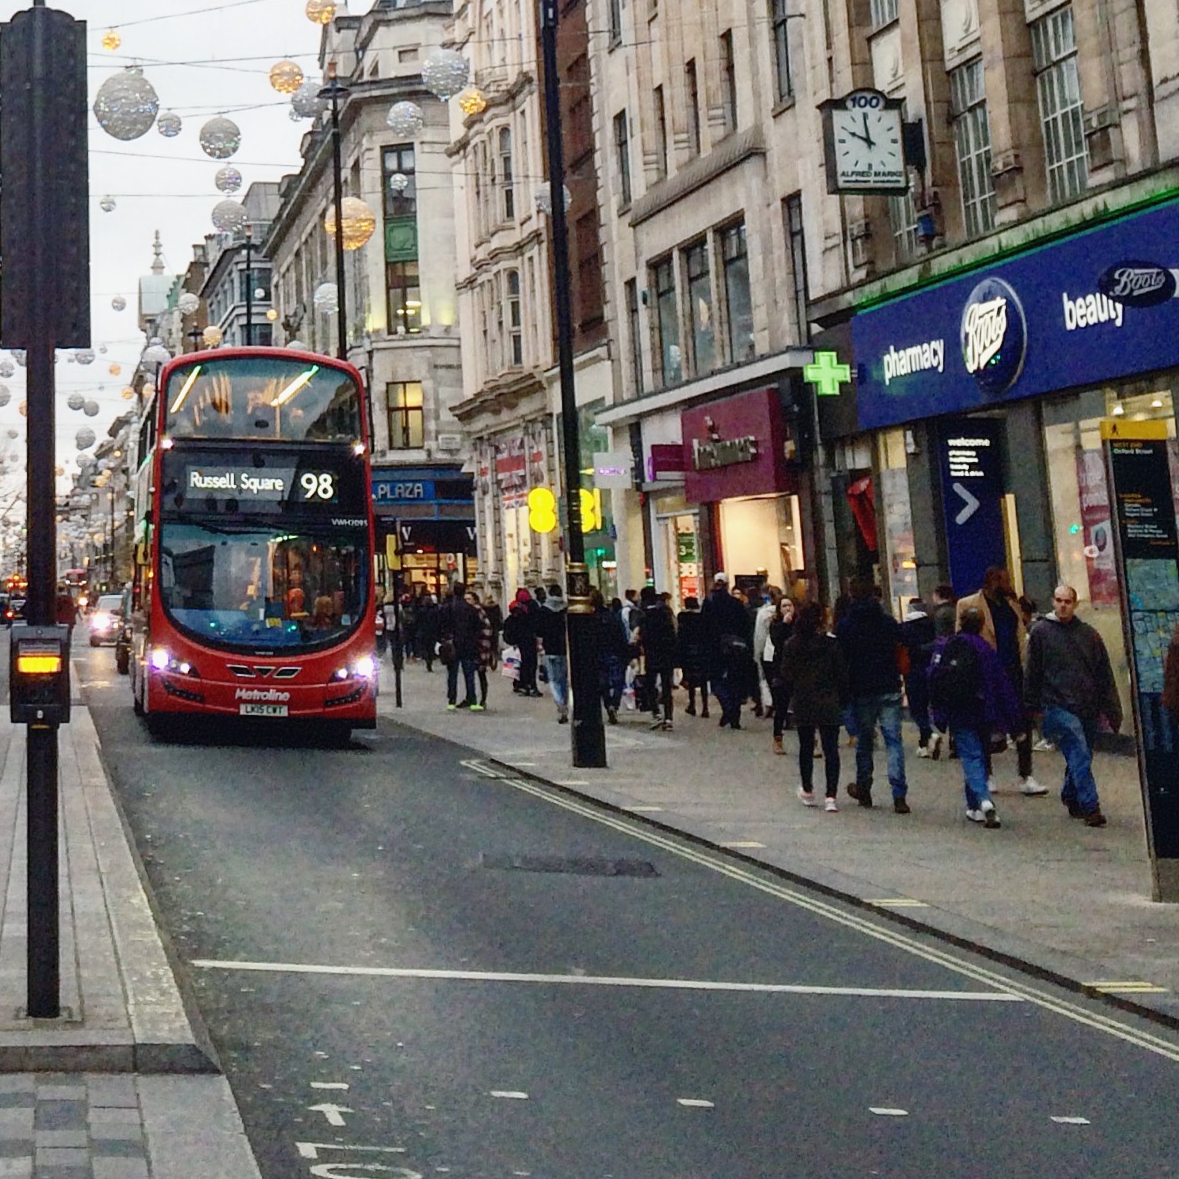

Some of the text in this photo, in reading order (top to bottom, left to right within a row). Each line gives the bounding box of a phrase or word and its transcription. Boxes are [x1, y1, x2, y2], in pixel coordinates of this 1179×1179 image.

[850, 95, 880, 109] 100
[840, 170, 872, 178] ALFRED
[1109, 268, 1165, 297] Boots
[1062, 292, 1124, 330] beauty
[964, 296, 1007, 374] Boots
[883, 338, 945, 386] pharmacy
[947, 437, 991, 447] welcome
[190, 472, 334, 499] Russell Square 98
[377, 483, 424, 499] PLAZA
[235, 688, 290, 701] Metroline
